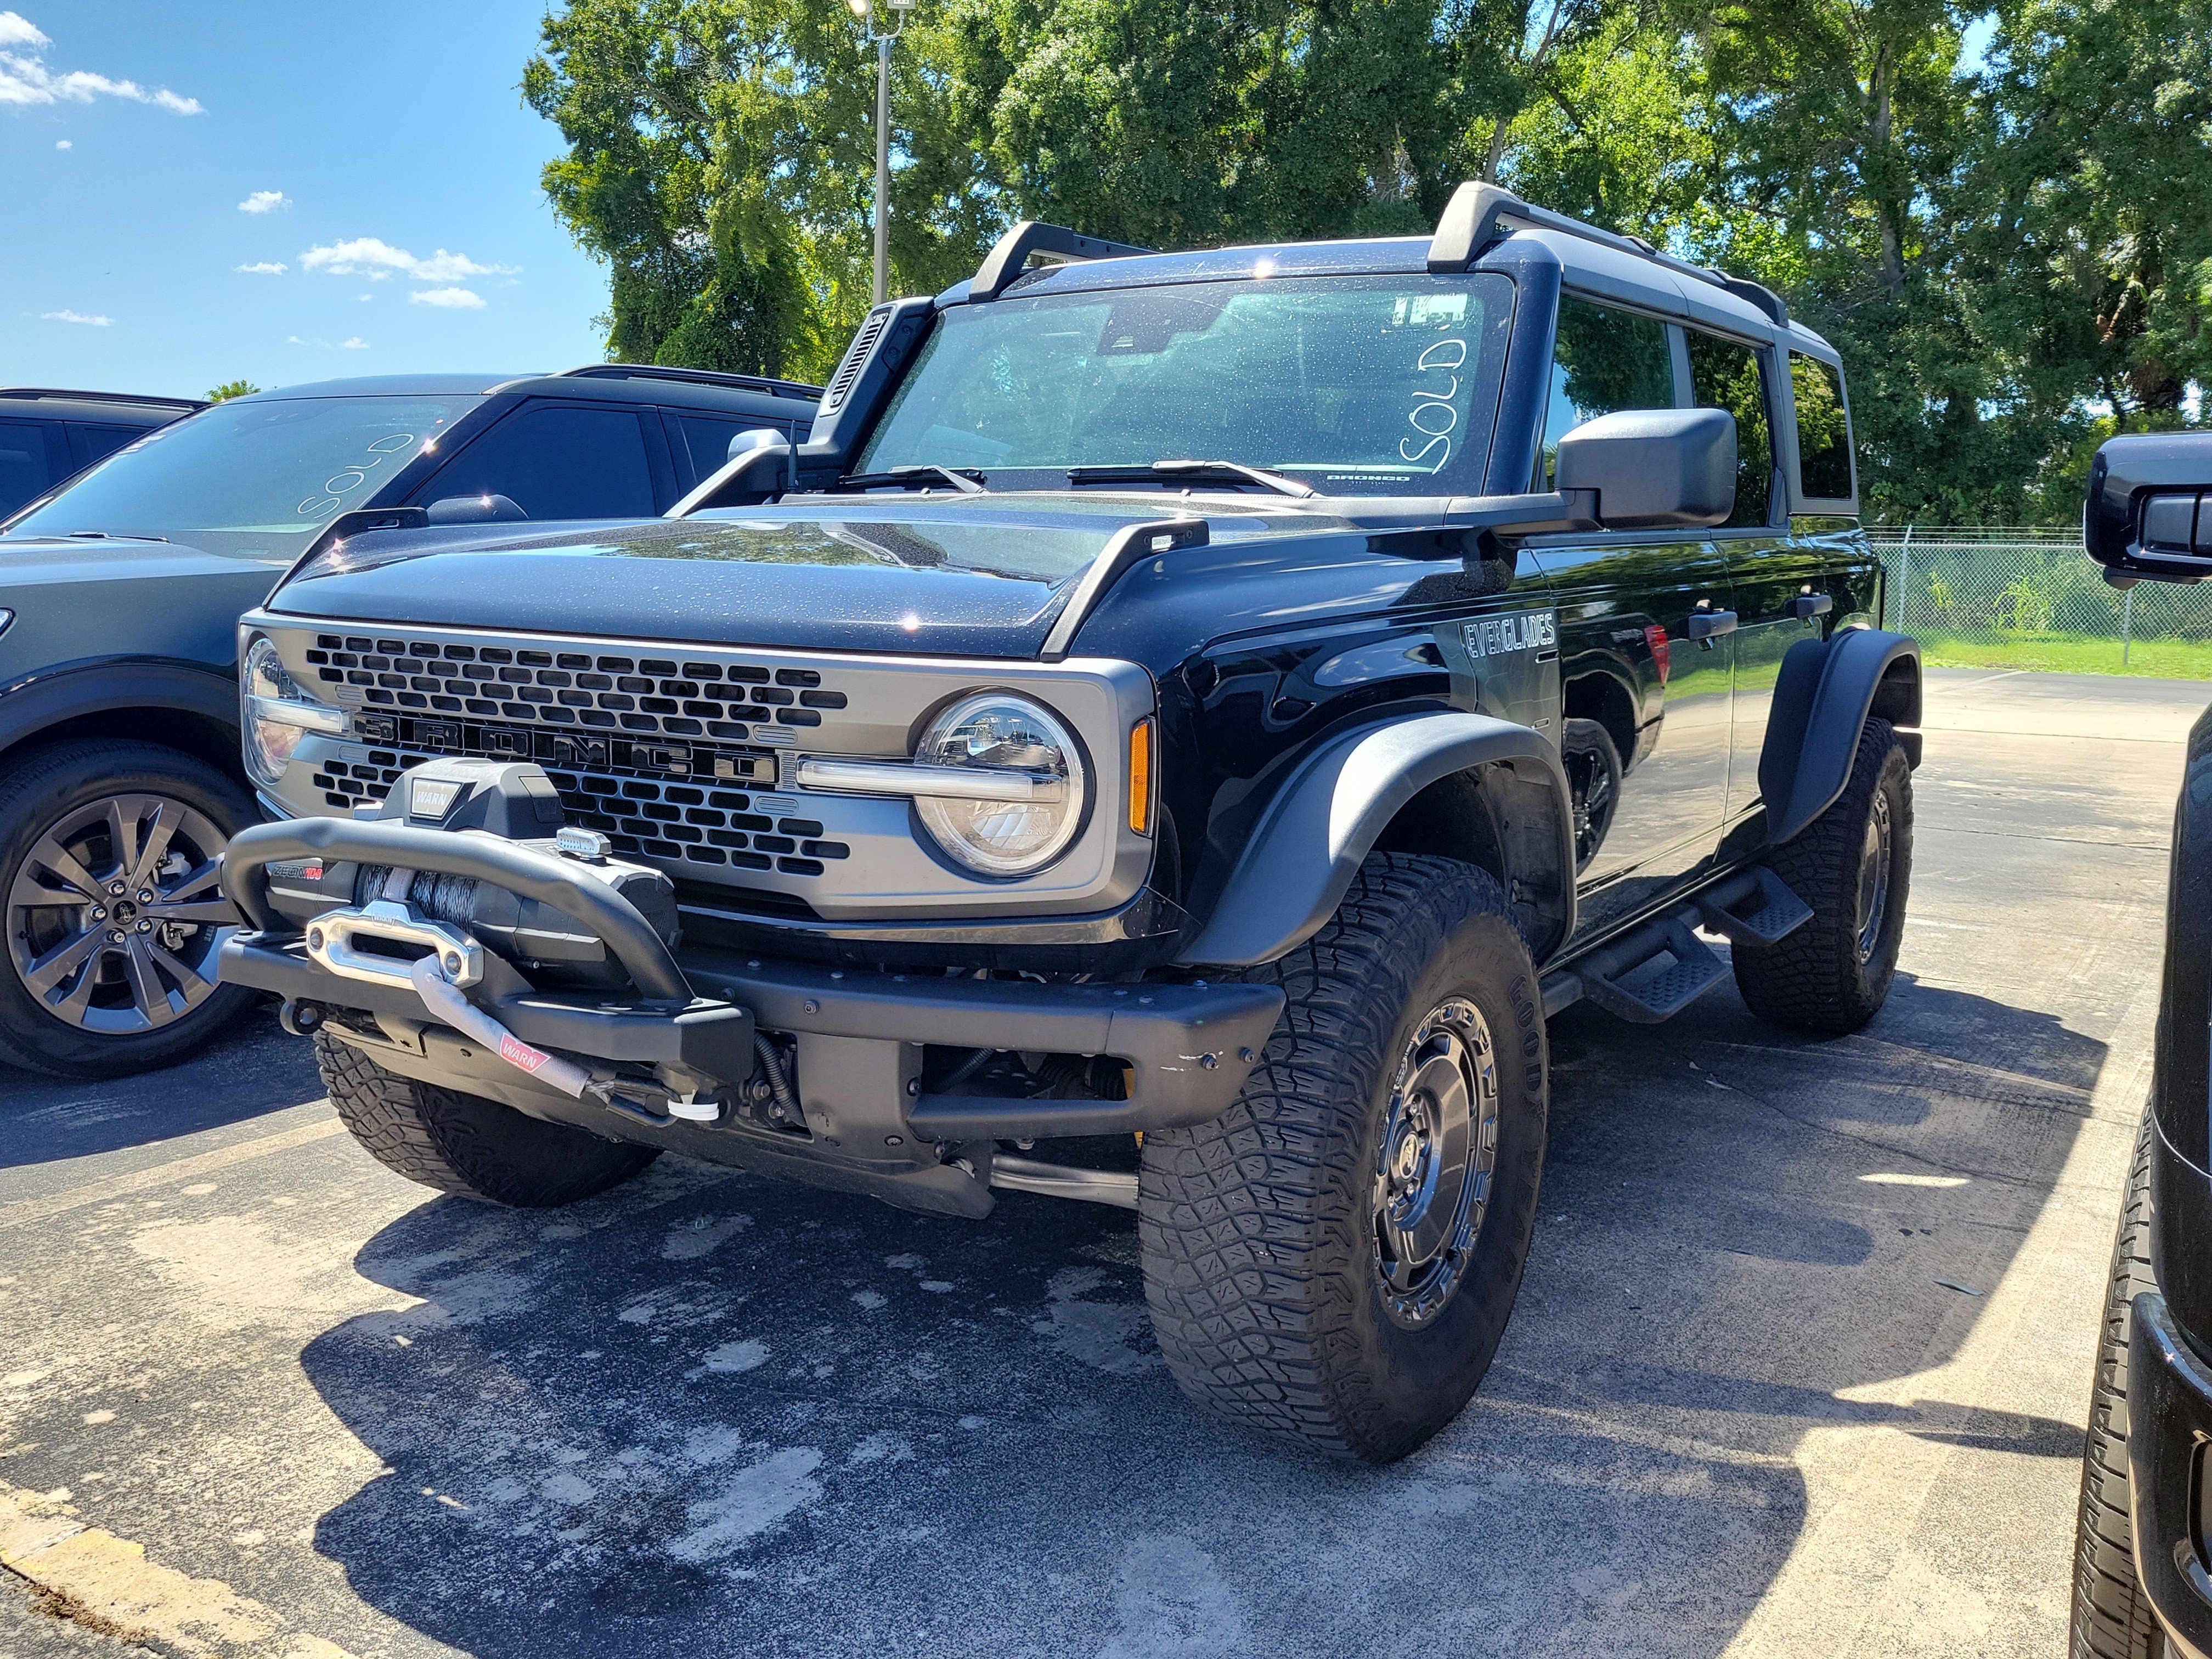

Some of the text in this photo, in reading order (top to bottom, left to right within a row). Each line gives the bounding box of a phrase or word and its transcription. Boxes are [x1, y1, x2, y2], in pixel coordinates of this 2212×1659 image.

[1400, 339, 1466, 475] SOLD
[297, 433, 415, 519] SOLD
[1464, 613, 1555, 658] EVERGLADES
[353, 712, 777, 783] BRONCO
[416, 791, 447, 805] WARN
[503, 1043, 538, 1068] WARN
